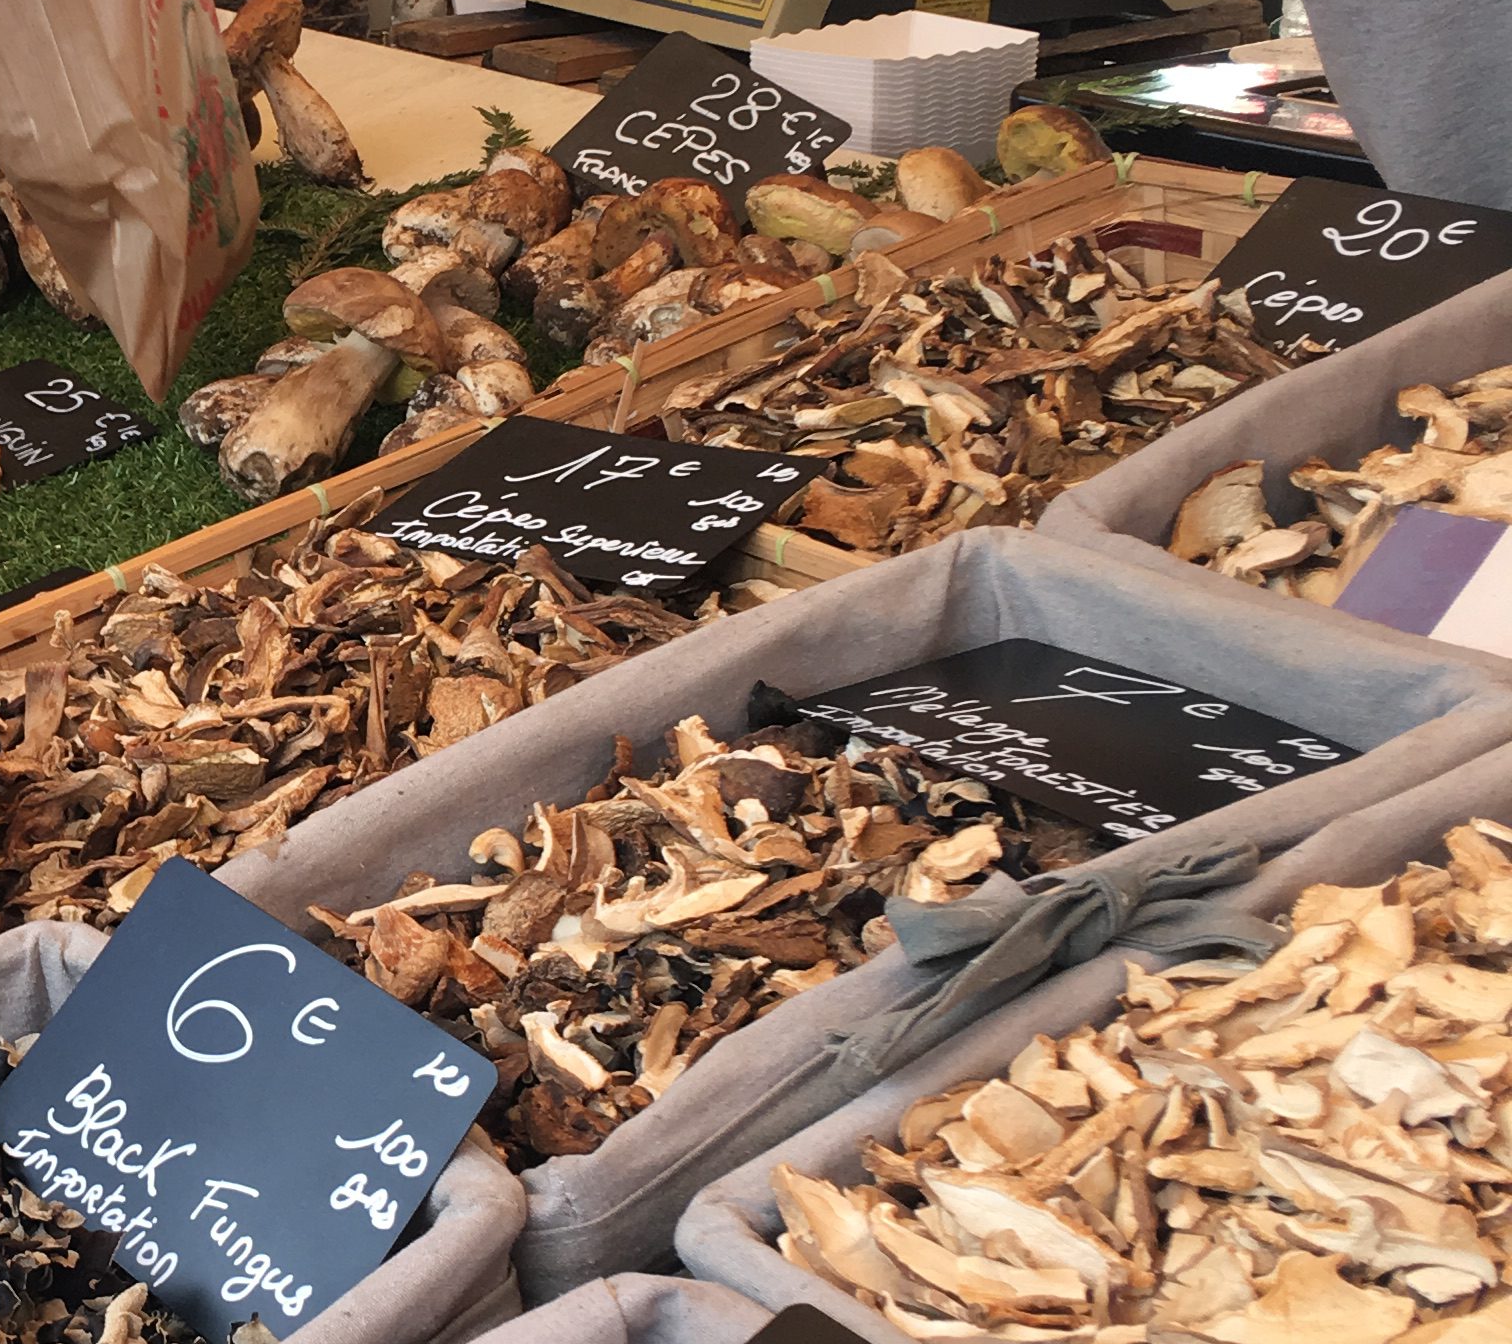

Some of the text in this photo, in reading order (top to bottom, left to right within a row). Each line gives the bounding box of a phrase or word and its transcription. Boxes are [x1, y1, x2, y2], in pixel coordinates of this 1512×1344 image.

[689, 73, 783, 131] 28
[1321, 199, 1479, 261] 20 €
[24, 378, 102, 414] 25
[503, 445, 662, 491] 17
[687, 489, 765, 514] 100
[1191, 742, 1296, 775] 100
[166, 943, 297, 1063] 6
[335, 1119, 428, 1178] 100
[47, 1063, 314, 1318] Black Fungus
